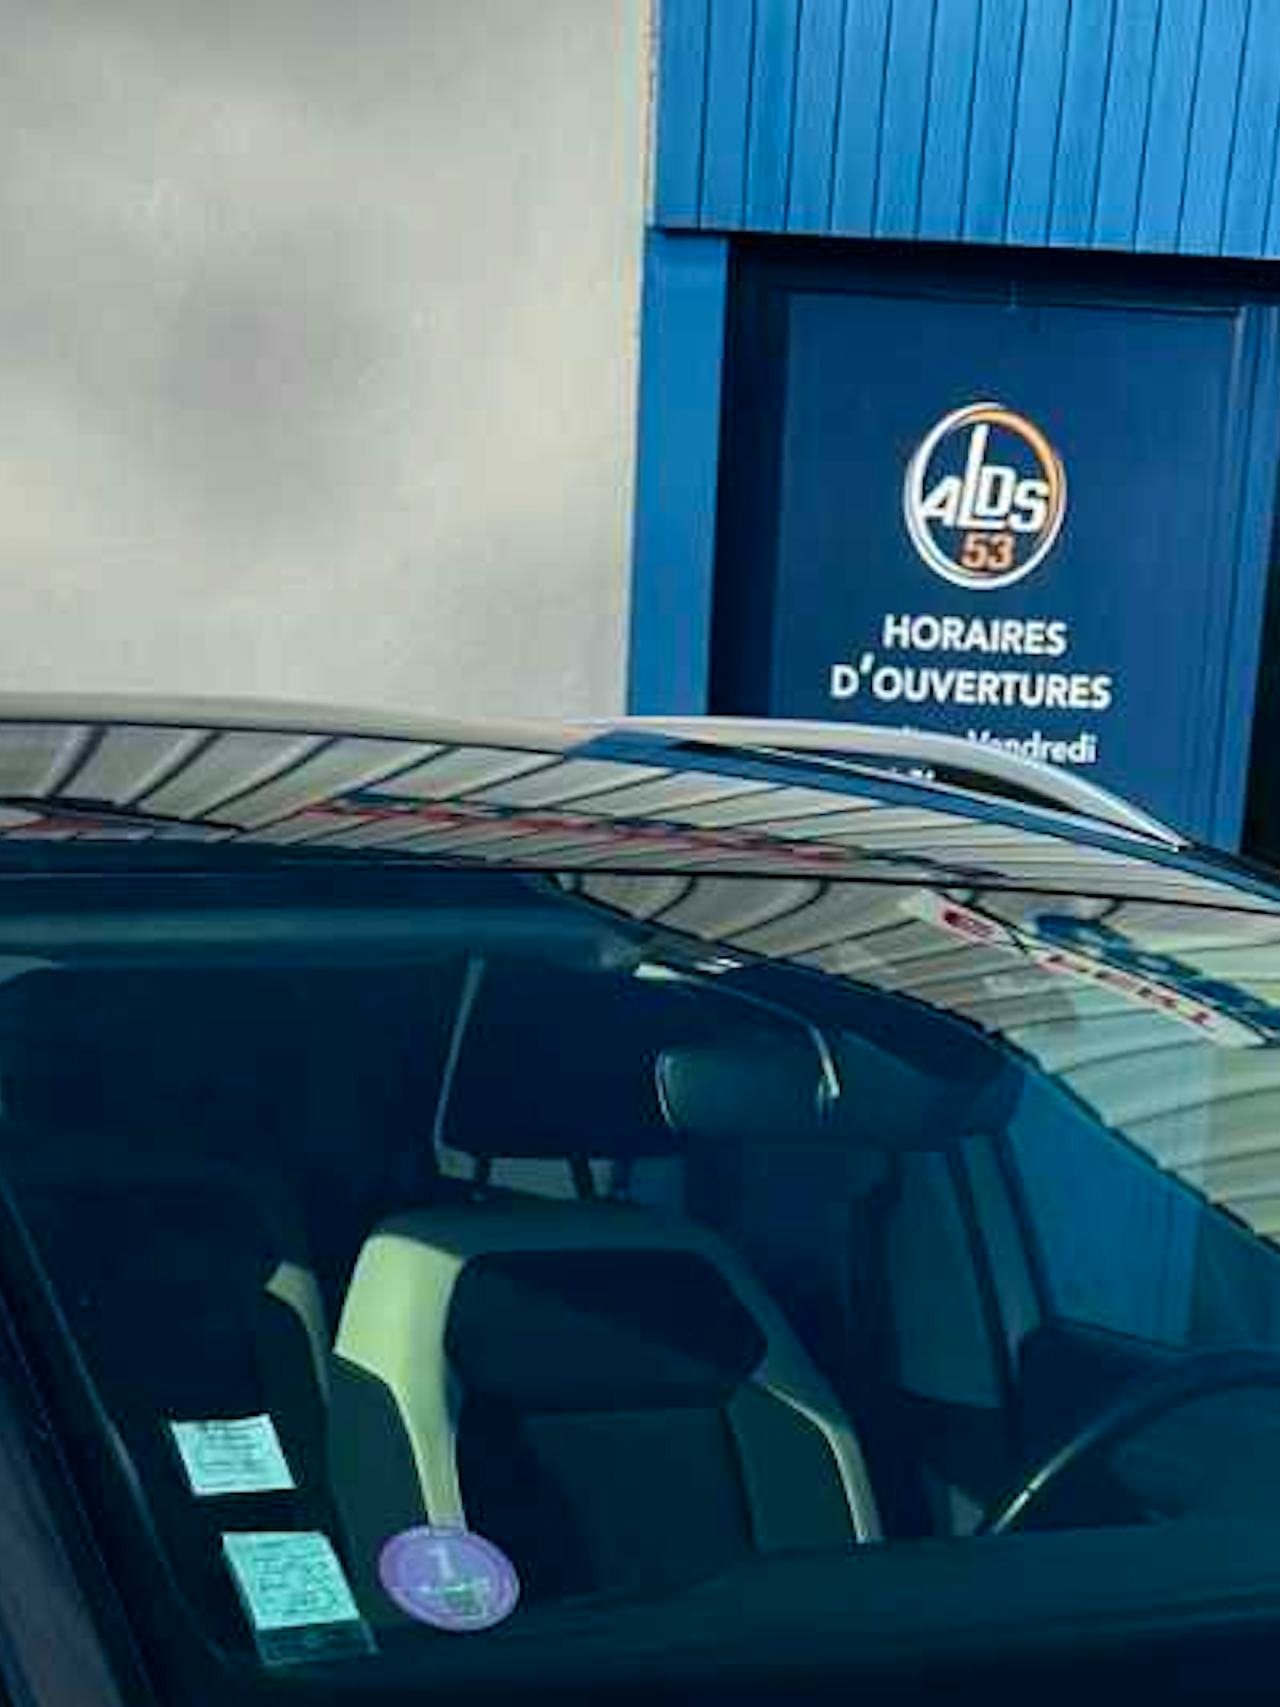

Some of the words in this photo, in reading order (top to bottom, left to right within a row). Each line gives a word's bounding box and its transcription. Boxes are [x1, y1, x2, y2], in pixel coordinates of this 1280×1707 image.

[960, 534, 1015, 570] 53
[882, 613, 1068, 656] HORAIRES
[830, 653, 1113, 710] D'OUVERTURES
